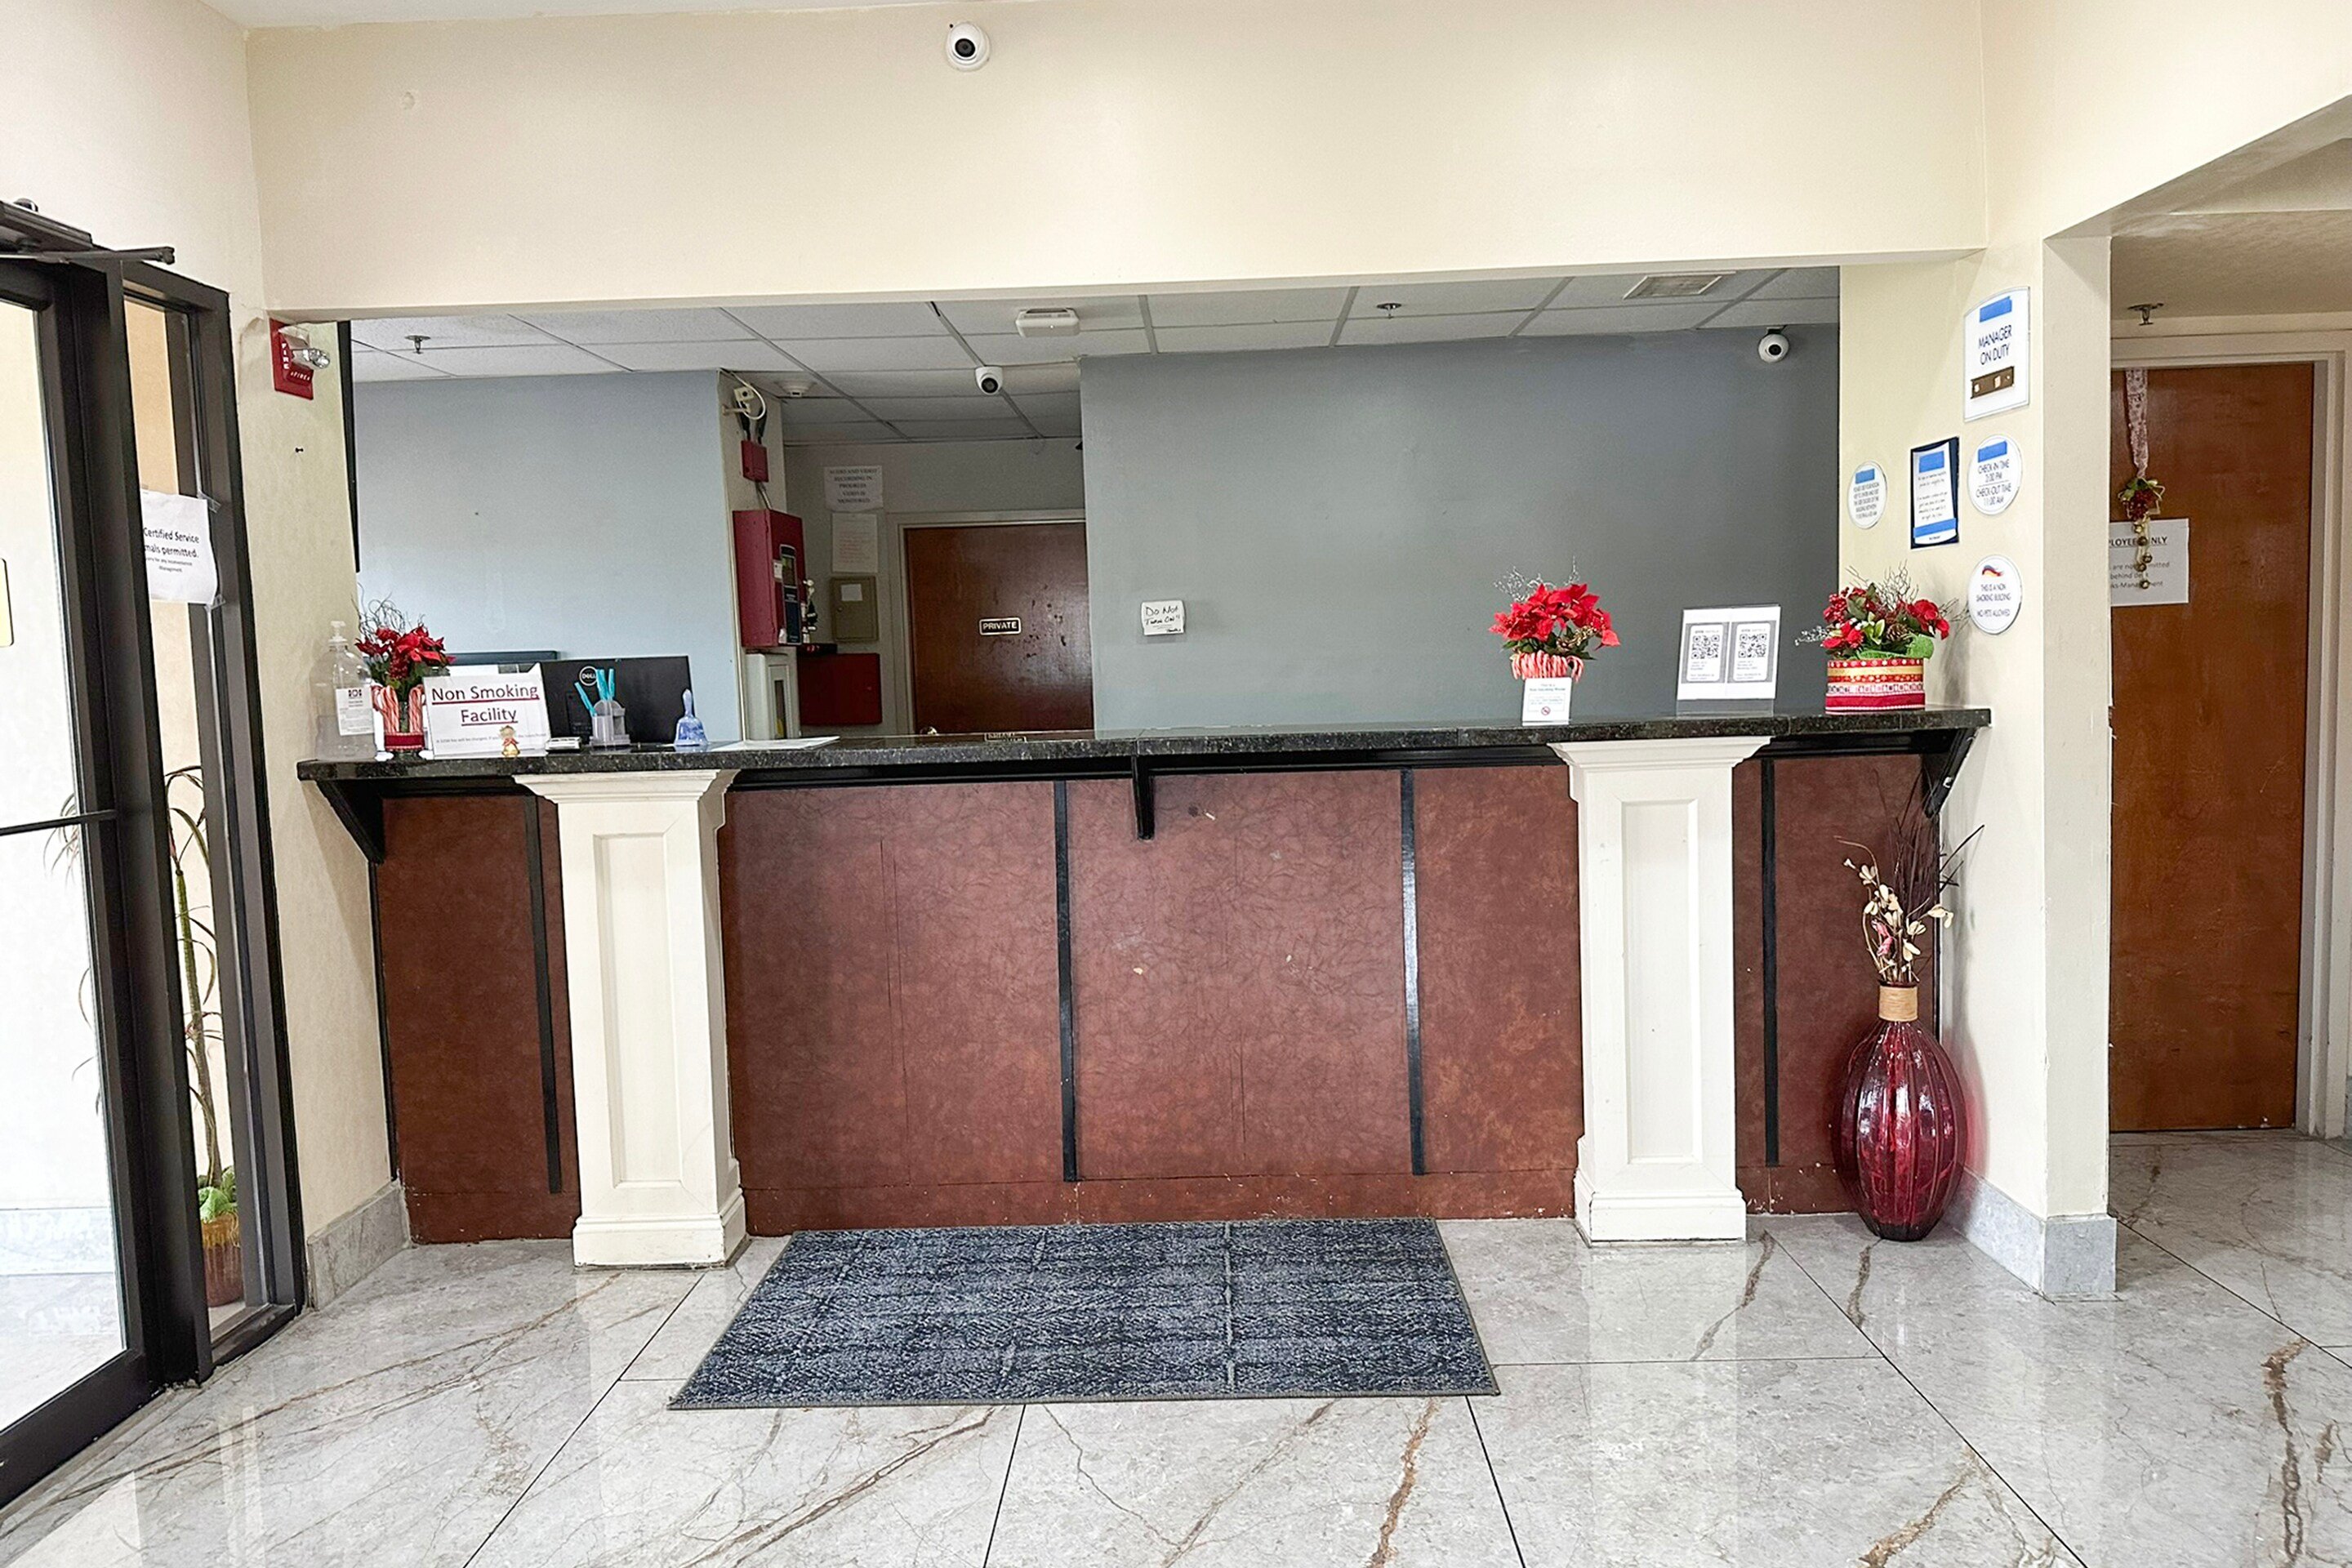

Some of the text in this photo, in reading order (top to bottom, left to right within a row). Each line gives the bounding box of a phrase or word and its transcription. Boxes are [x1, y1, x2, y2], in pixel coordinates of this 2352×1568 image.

[1978, 324, 2012, 349] MANAGER
[281, 343, 290, 369] FIRE
[1980, 343, 2011, 365] ON DUTY
[144, 527, 199, 544] Certified Service
[2150, 537, 2167, 545] NLY
[1145, 606, 1159, 617] Do
[982, 621, 1018, 630] PRIVATE
[431, 684, 539, 701] Non Smoking
[461, 707, 517, 723] Facility
